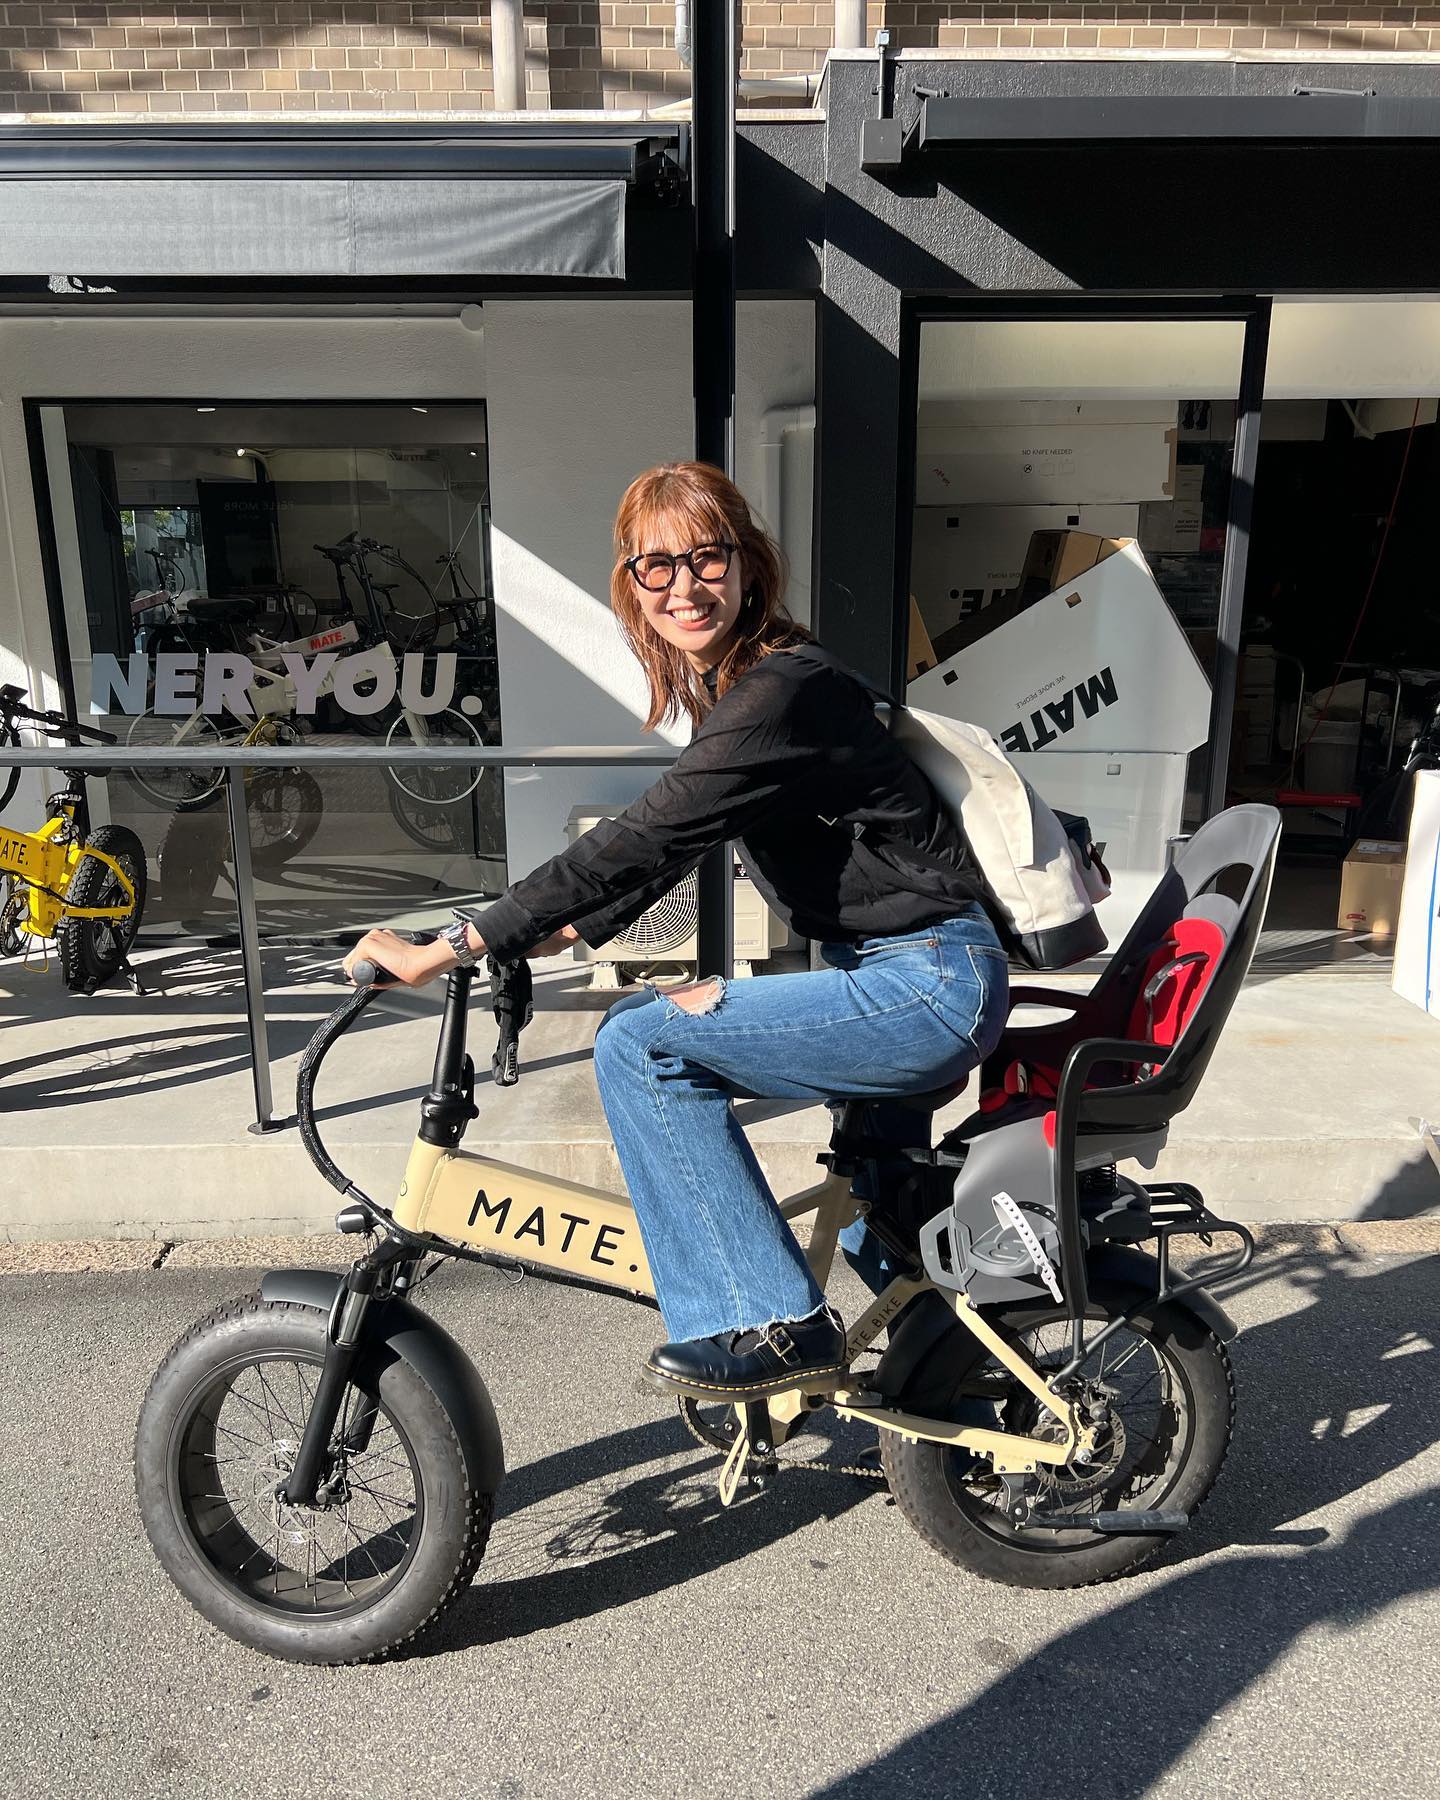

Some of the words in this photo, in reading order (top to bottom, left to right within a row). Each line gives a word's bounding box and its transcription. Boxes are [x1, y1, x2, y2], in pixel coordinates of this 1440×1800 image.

[310, 631, 346, 650] MATE.
[90, 653, 254, 714] NER
[281, 653, 483, 715] YOU.
[1039, 682, 1056, 696] MOVE
[1055, 674, 1066, 684] WE
[1015, 692, 1038, 709] PEOPLE
[0, 836, 28, 865] ATE.
[467, 1189, 638, 1272] MATE.
[845, 1296, 902, 1361] ATE.BIKE
